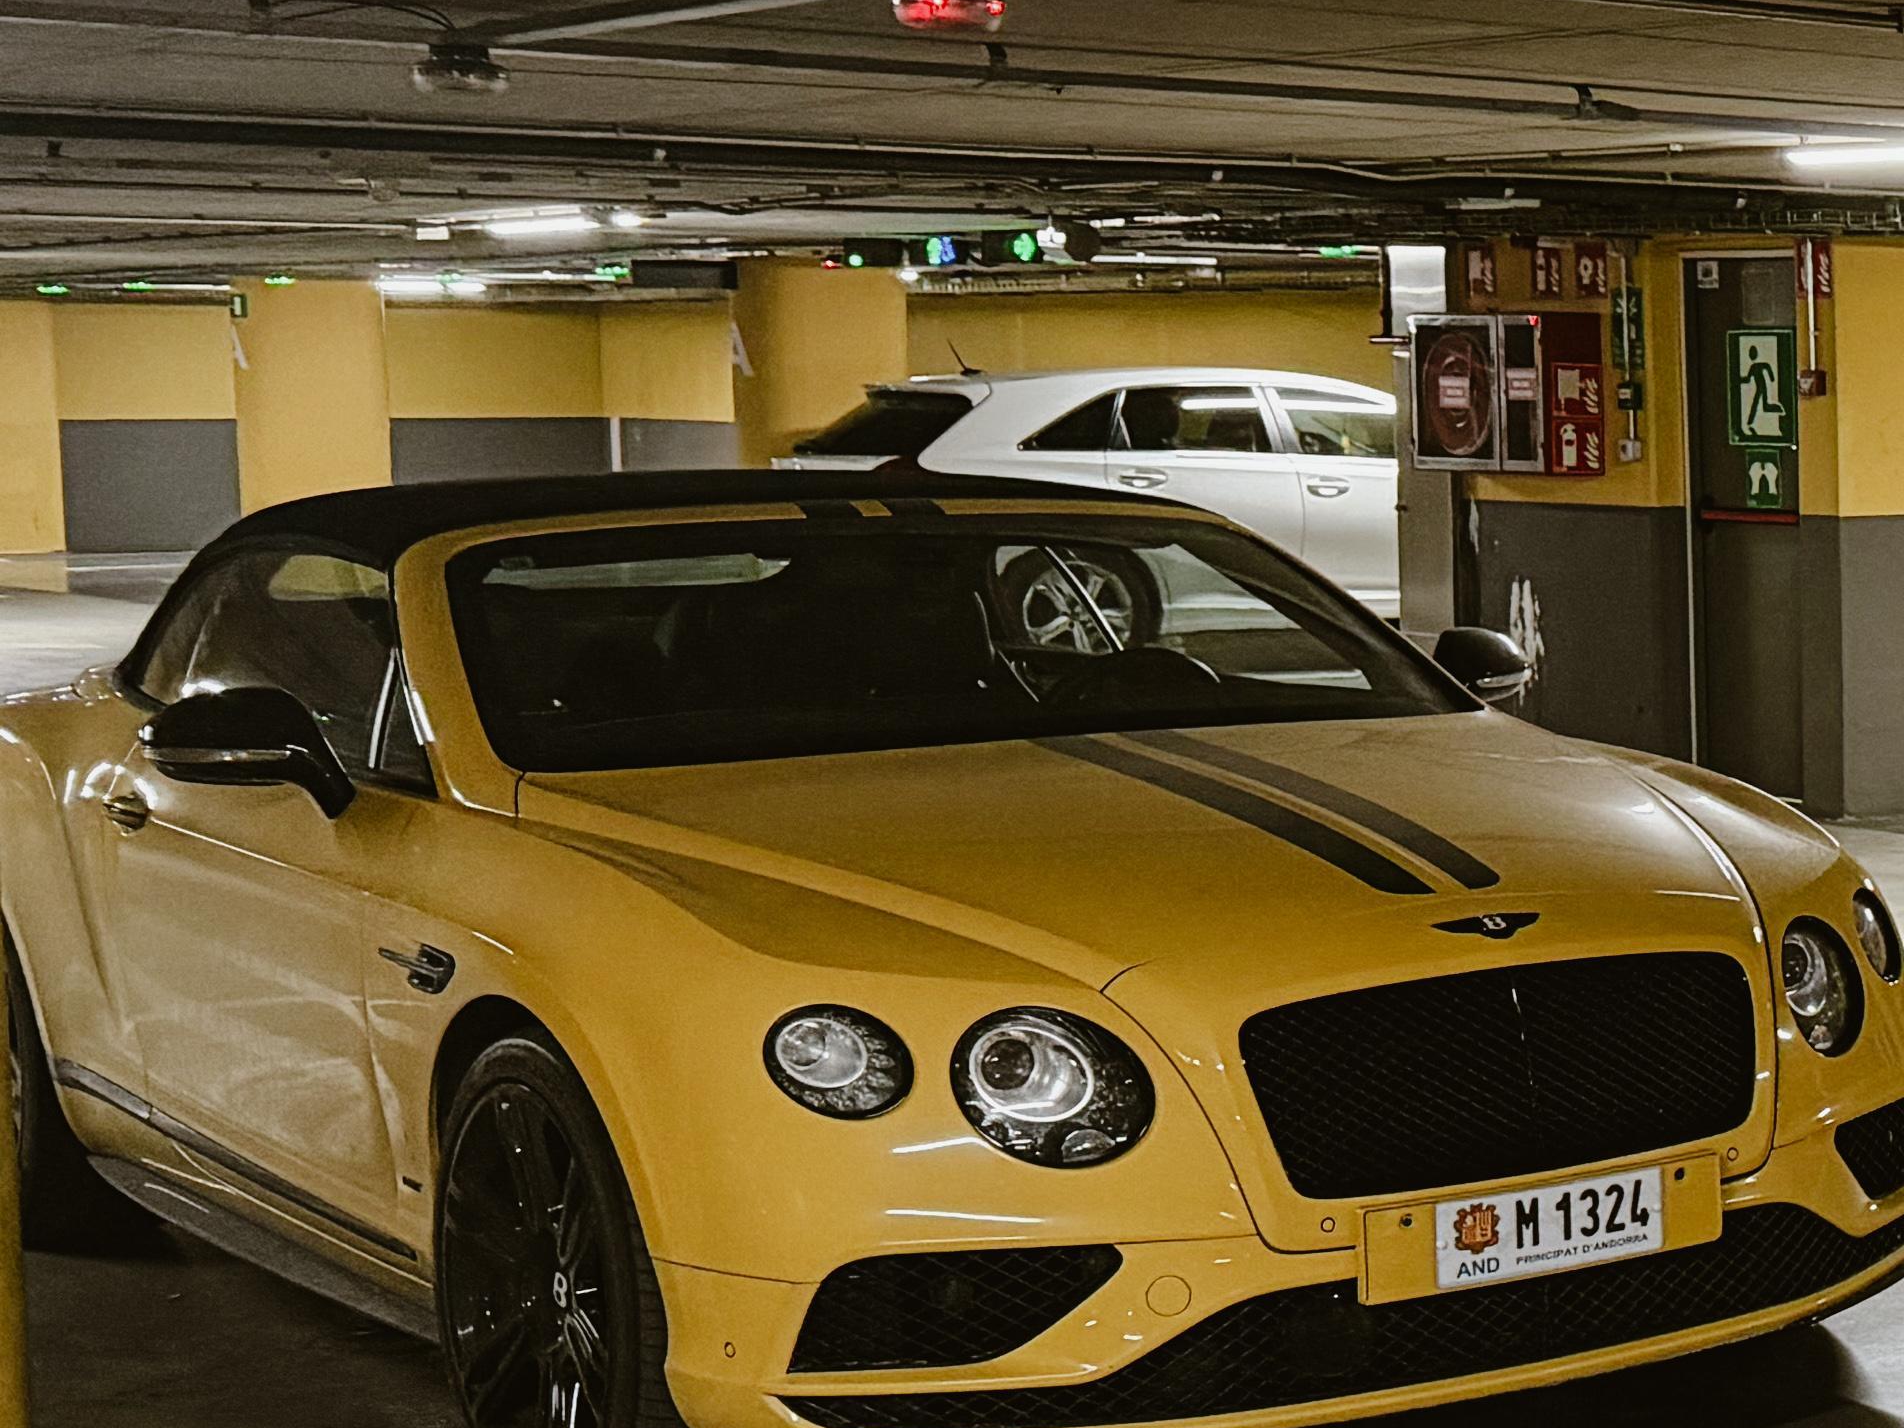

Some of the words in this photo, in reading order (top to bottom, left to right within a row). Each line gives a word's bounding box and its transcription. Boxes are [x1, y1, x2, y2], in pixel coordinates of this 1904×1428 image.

[1515, 1196, 1540, 1250] M
[1555, 1178, 1650, 1241] 1324
[1456, 1256, 1500, 1280] AND
